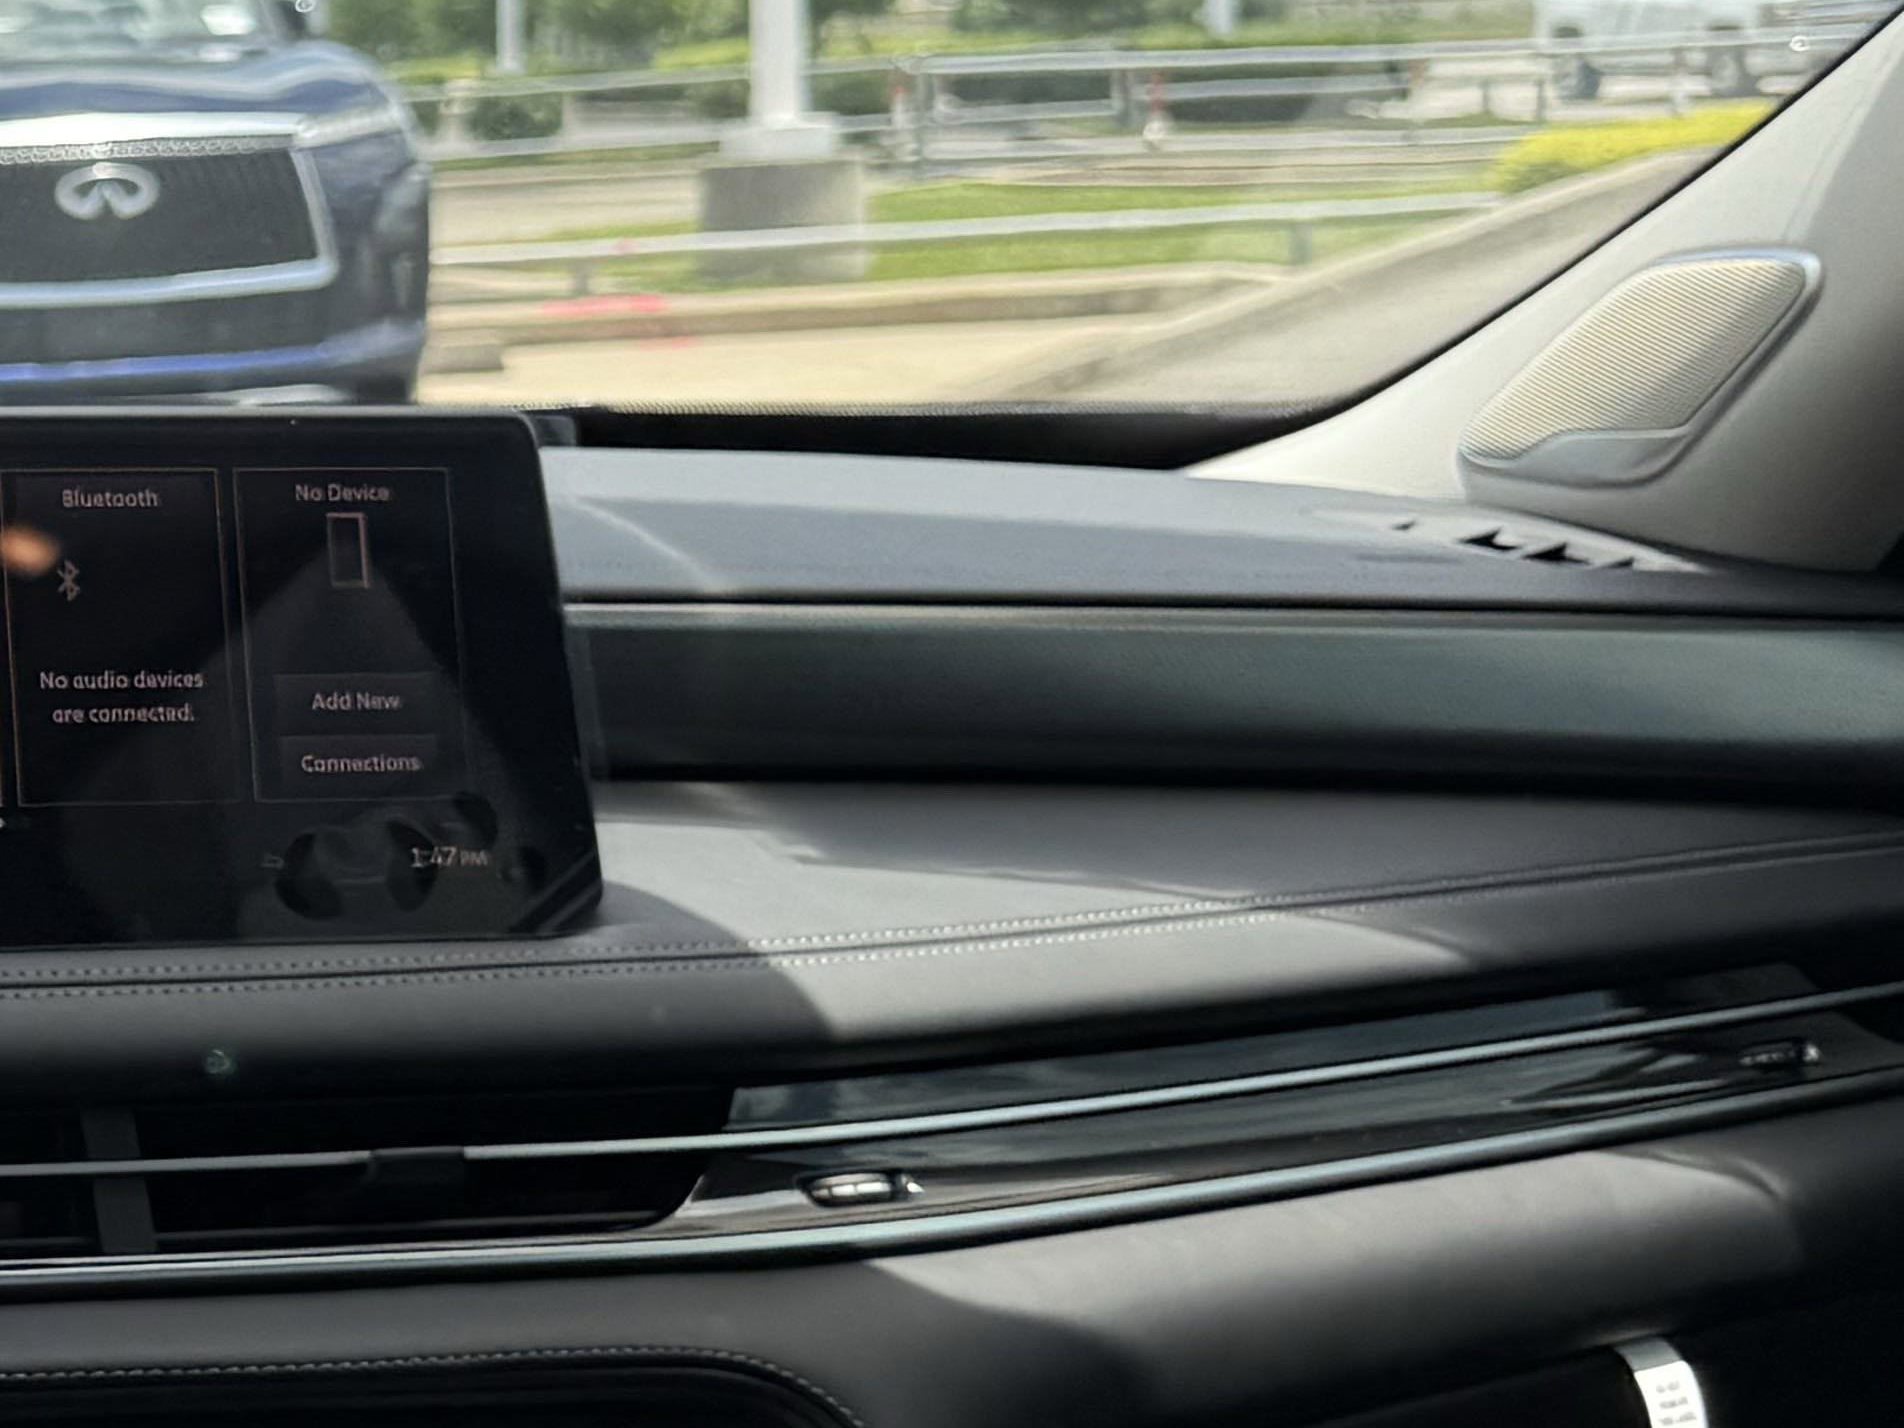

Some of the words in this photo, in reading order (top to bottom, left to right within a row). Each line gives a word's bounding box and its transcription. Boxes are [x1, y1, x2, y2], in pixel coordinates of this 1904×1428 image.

[62, 486, 160, 509] Bluetooth
[295, 484, 322, 502] No
[327, 483, 391, 502] Device
[39, 671, 67, 689] No
[72, 670, 129, 689] audio
[133, 670, 205, 689] devices
[311, 692, 352, 711] Add
[357, 692, 401, 711] New
[51, 706, 84, 723] are
[88, 704, 195, 723] connected.
[300, 753, 422, 773] Connections
